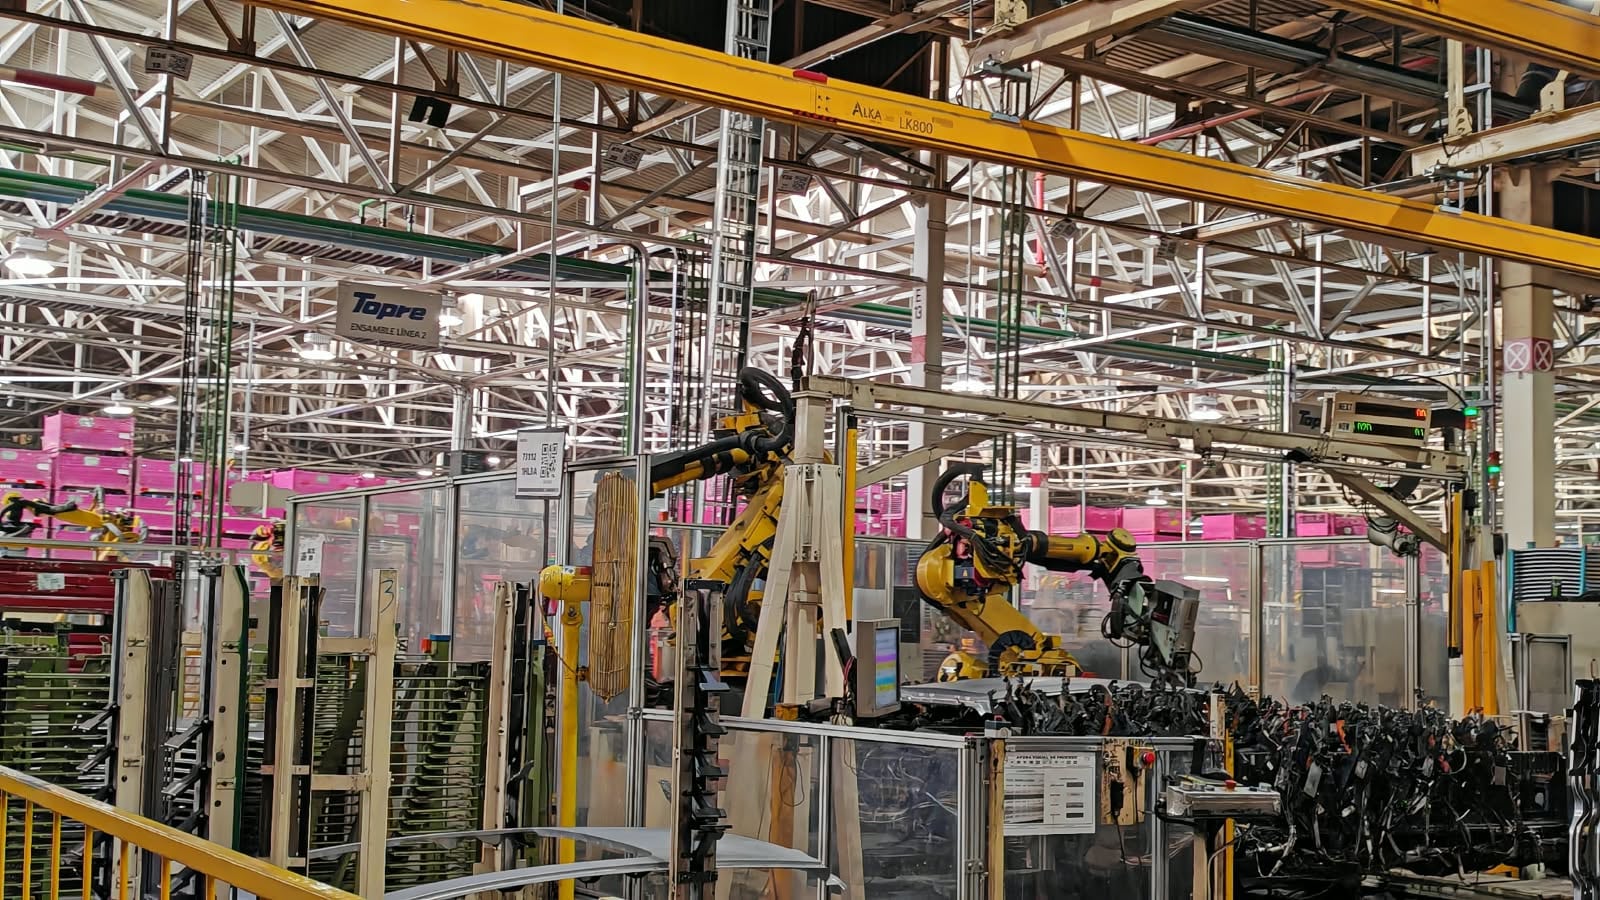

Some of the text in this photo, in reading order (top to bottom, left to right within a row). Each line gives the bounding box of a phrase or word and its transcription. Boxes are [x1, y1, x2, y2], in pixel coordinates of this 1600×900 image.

[899, 116, 934, 134] LK800
[352, 291, 427, 321] Topre
[350, 322, 427, 339] ENSAMBLE LÍNEA 2
[1298, 409, 1322, 430] Top
[379, 579, 395, 614] 3
